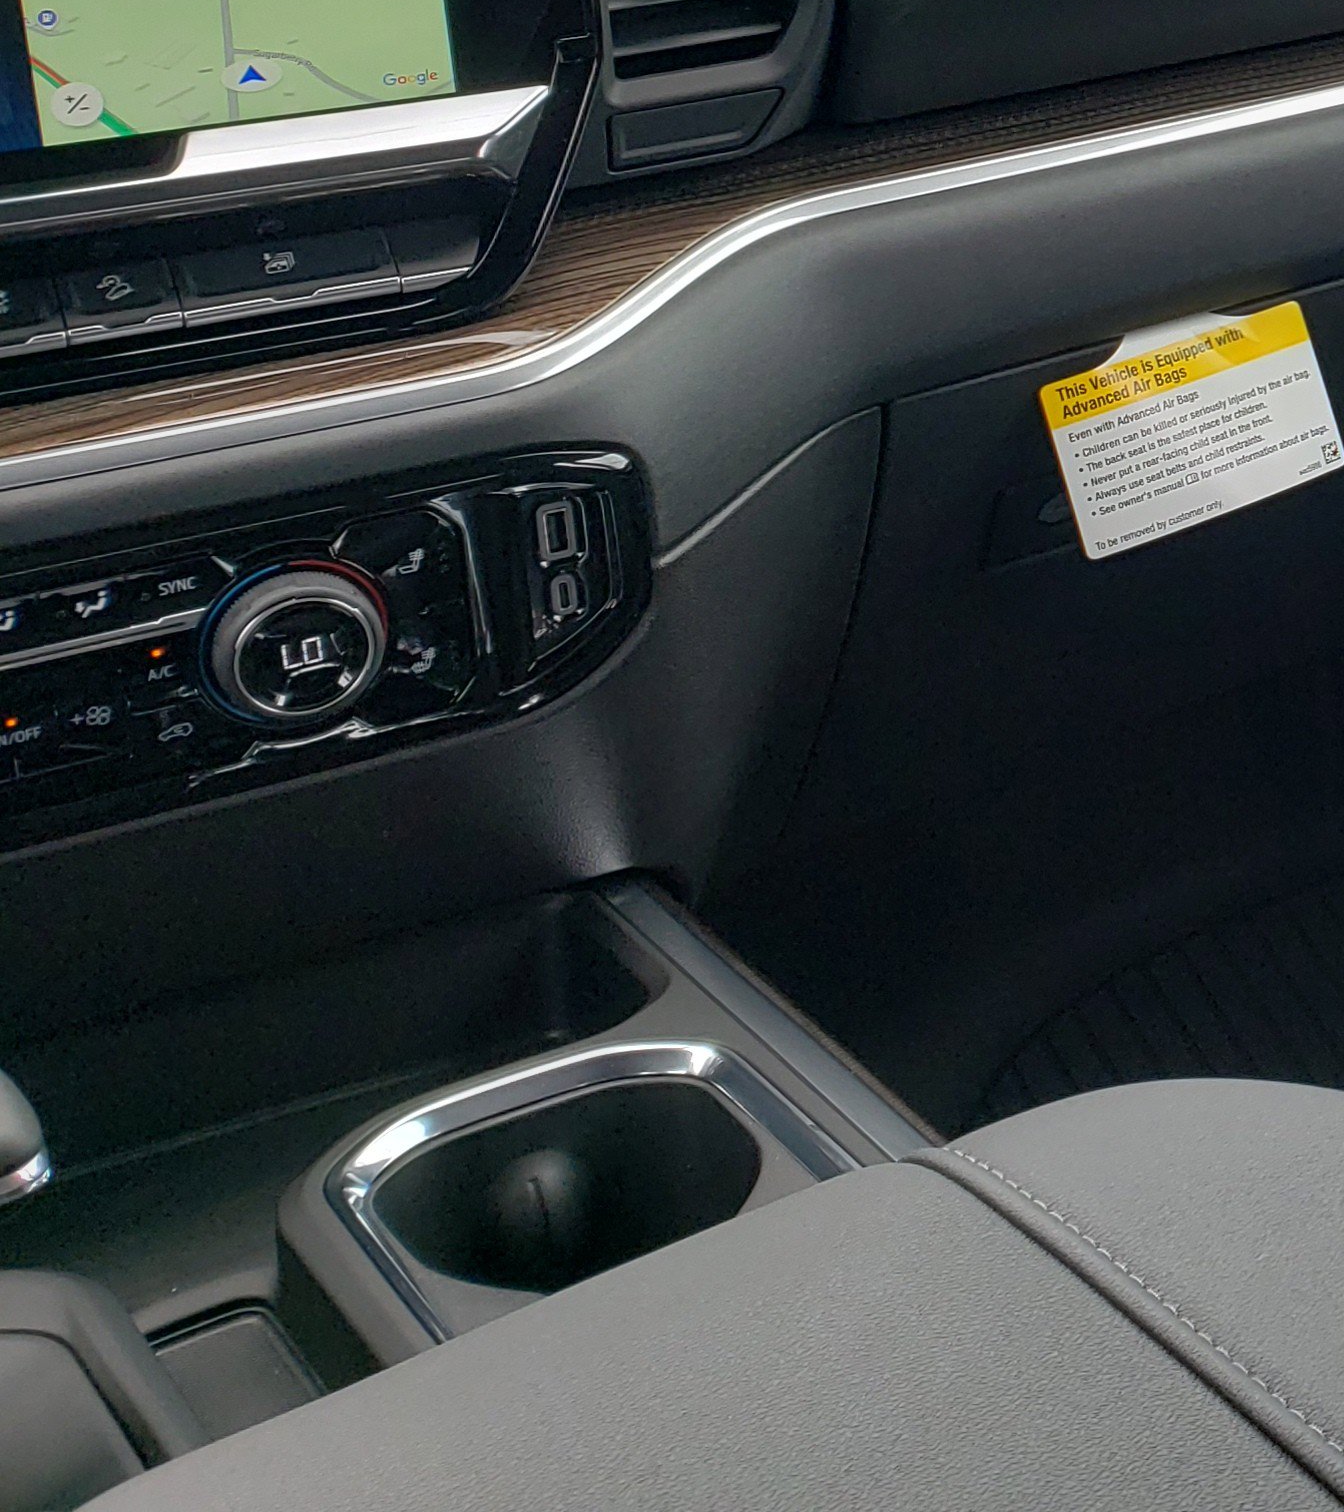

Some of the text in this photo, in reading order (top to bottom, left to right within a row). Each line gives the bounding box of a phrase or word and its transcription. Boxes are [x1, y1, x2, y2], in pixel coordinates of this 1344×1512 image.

[382, 68, 439, 87] Google
[1056, 328, 1244, 402] This Vehicle is Equipped with
[1063, 367, 1187, 419] Advanced Air Bags
[1068, 391, 1199, 442] Even with Advanced Air Bags
[1082, 439, 1121, 457] Children
[1123, 432, 1139, 444] can
[1141, 427, 1152, 437] be
[1153, 417, 1177, 433] killed
[1179, 413, 1188, 422] or
[1191, 399, 1227, 419] seriously
[1256, 384, 1267, 395] by
[1268, 379, 1281, 390] the
[1283, 375, 1293, 386] air
[1086, 460, 1103, 472] The
[1105, 451, 1126, 466] back
[1128, 446, 1147, 458] seat
[1148, 441, 1156, 451] is
[1157, 436, 1171, 448] the
[1172, 426, 1197, 442] safest
[1200, 419, 1220, 434] place
[1221, 413, 1232, 424] for
[1090, 472, 1116, 487] Never
[1119, 465, 1134, 478] put
[1135, 463, 1142, 472] a
[1143, 445, 1189, 469] rear-facing
[1190, 437, 1210, 452] child
[1211, 431, 1229, 444] seat
[1229, 427, 1238, 438] in
[1238, 422, 1251, 434] the
[1095, 485, 1127, 501] Always
[1129, 478, 1144, 490] use
[1146, 470, 1164, 483] seat
[1166, 462, 1187, 476] belts
[1188, 455, 1204, 468] and
[1205, 447, 1225, 462] child
[1099, 502, 1116, 516] See
[1118, 491, 1152, 508] owner's
[1154, 479, 1185, 496] manual
[1201, 469, 1212, 480] for
[1214, 462, 1234, 474] more
[1235, 443, 1278, 467] information
[1279, 435, 1299, 450] about
[1300, 430, 1309, 442] air
[1096, 541, 1106, 551] To
[1107, 536, 1119, 547] be
[1120, 524, 1156, 543] removed
[1157, 519, 1167, 531] by
[1168, 506, 1204, 526] customer
[158, 576, 197, 597] SYNC
[148, 664, 177, 682] A/C
